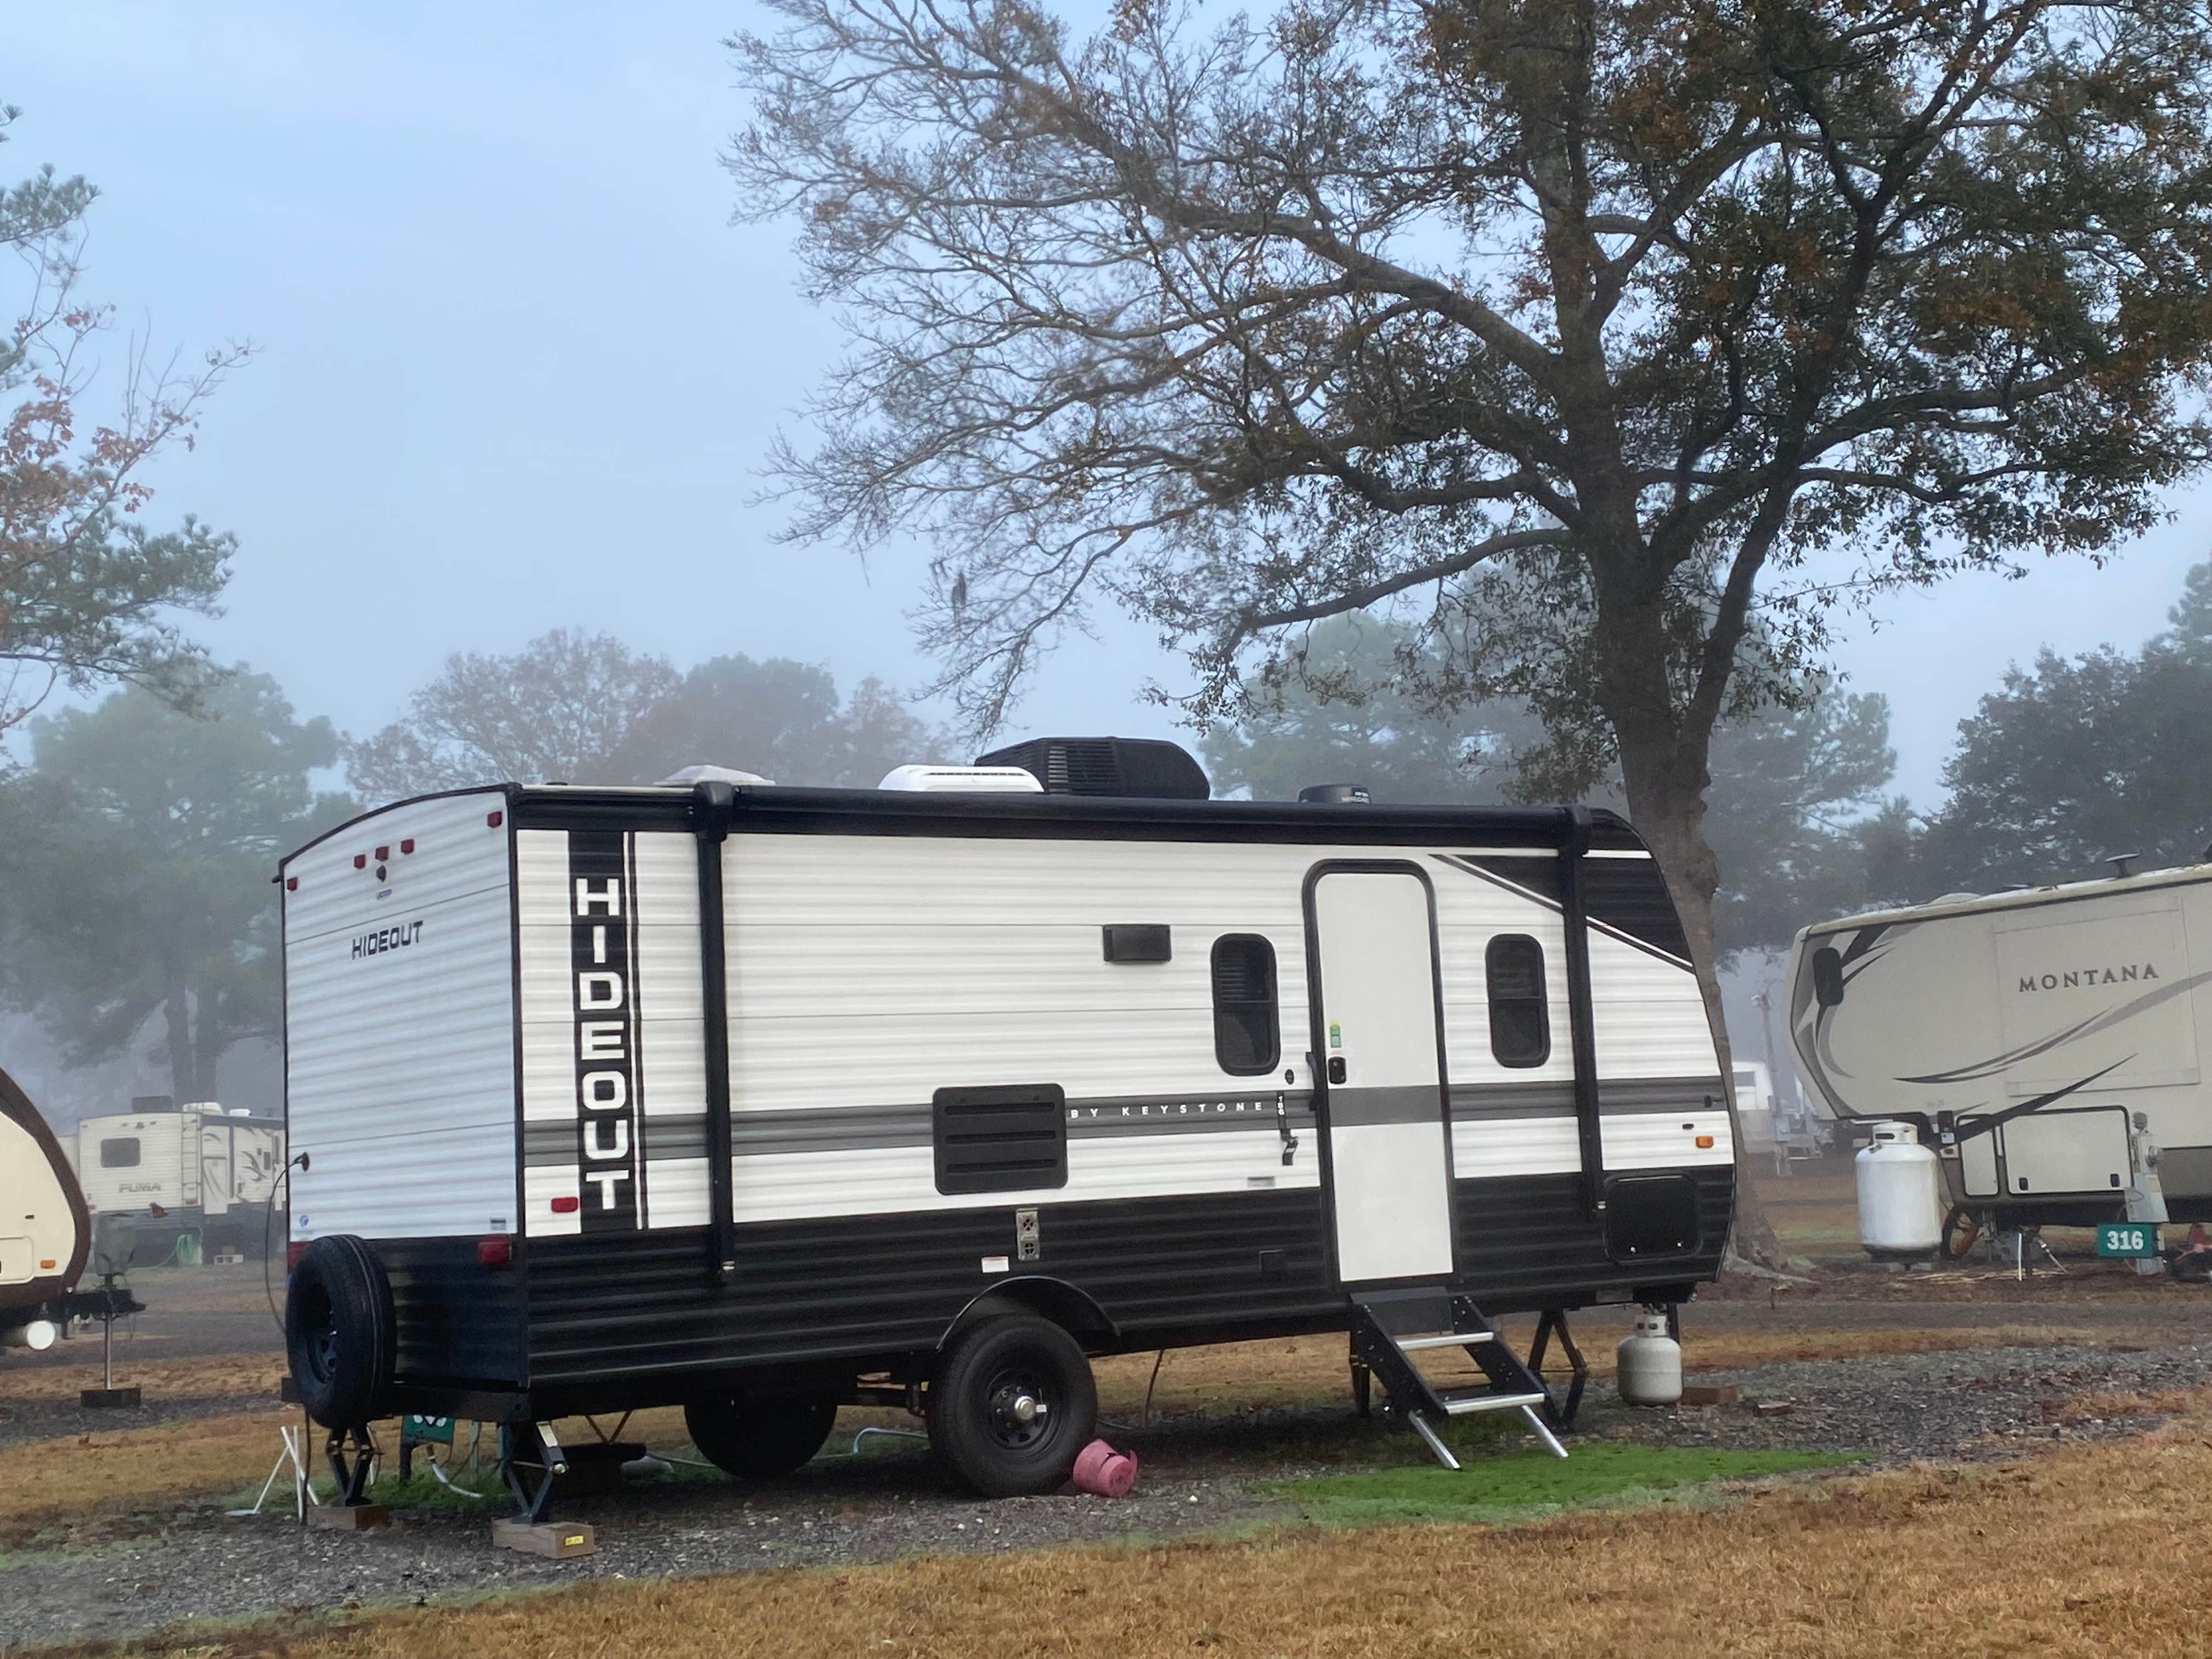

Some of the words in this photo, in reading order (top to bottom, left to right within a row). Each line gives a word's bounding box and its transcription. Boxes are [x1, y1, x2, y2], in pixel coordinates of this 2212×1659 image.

[352, 920, 423, 960] HIDEOUT
[2019, 963, 2159, 992] MONTANA
[576, 878, 629, 1210] HIDEOUT
[1070, 1108, 1098, 1119] BY
[1122, 1102, 1262, 1116] KEYSTONE
[2107, 1231, 2144, 1250] 316
